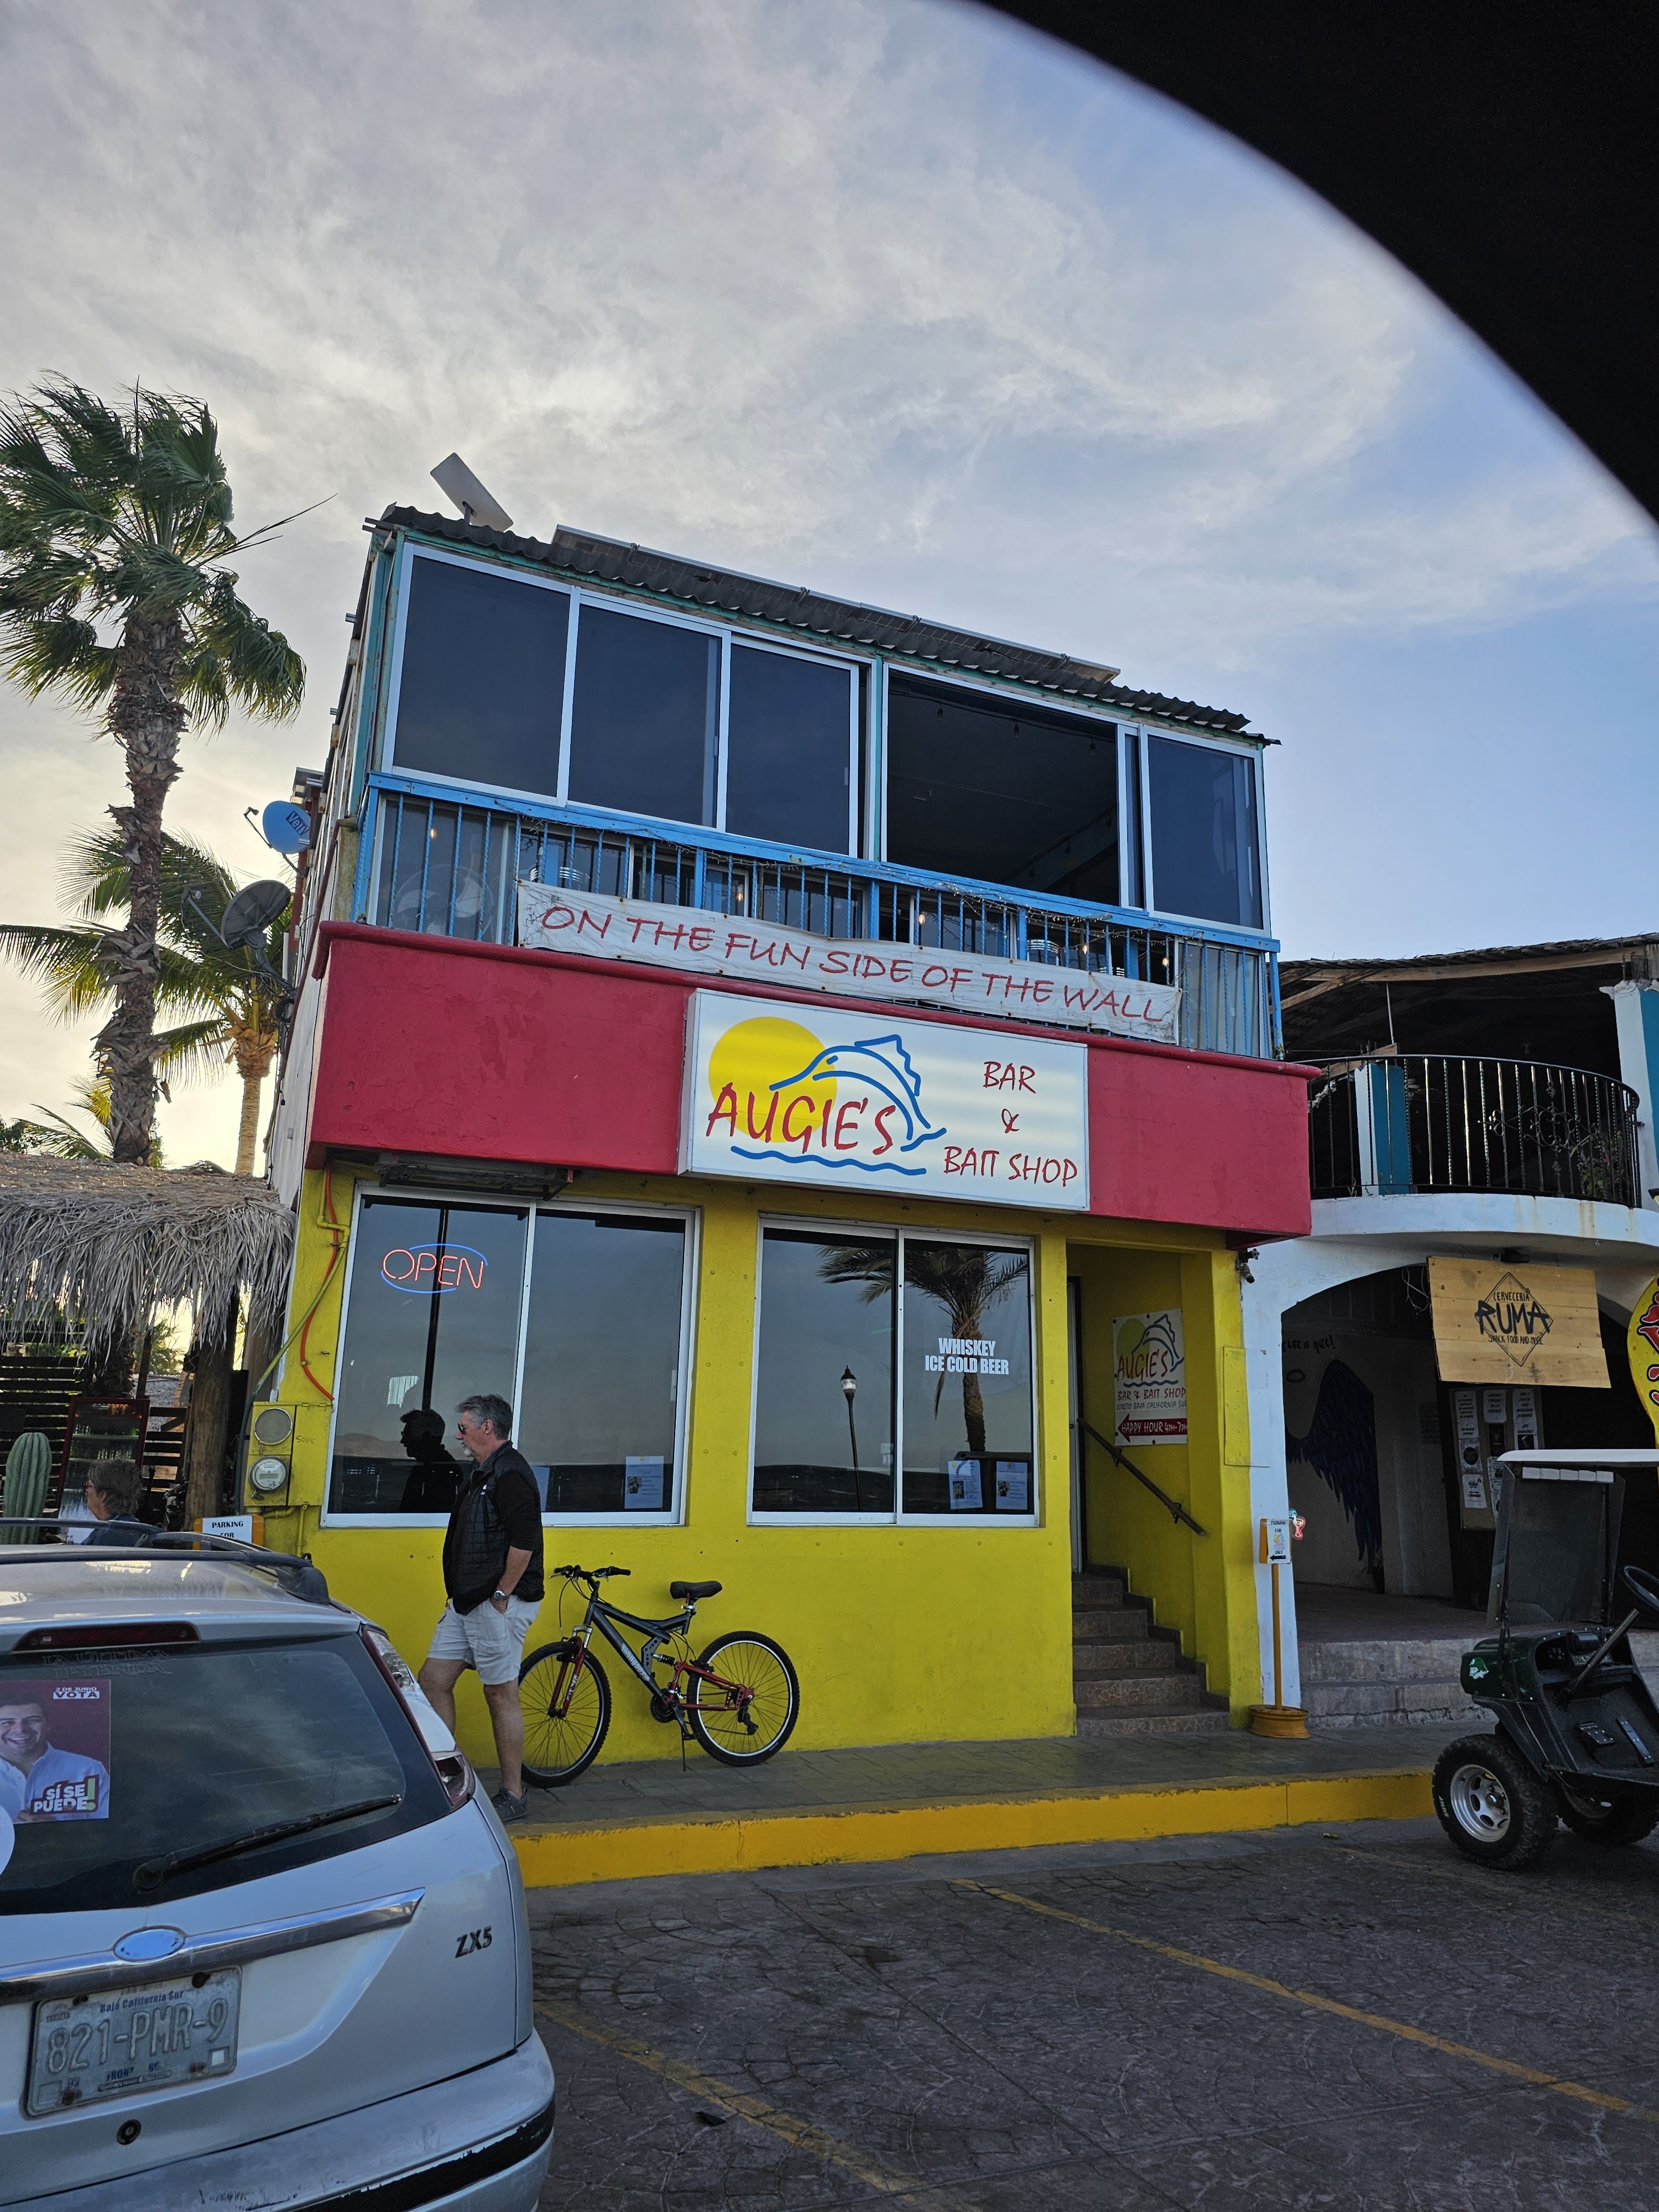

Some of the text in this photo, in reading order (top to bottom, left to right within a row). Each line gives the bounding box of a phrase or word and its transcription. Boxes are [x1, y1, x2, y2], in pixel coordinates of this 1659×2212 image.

[542, 906, 1163, 1022] ON THE FUN SIDE OF THE WALL
[983, 1061, 1036, 1094] BAR
[706, 1082, 896, 1156] AUGIE'S
[1001, 1108, 1020, 1134] &
[943, 1146, 1078, 1187] BAIT SHOP
[383, 1249, 484, 1290] OPEN
[1494, 1292, 1530, 1302] CERVECERIA
[1474, 1300, 1551, 1335] RUMA
[938, 1337, 996, 1357] WHISKEY
[1507, 1335, 1519, 1344] FOOD
[1520, 1335, 1530, 1344] AND
[925, 1355, 1009, 1375] ICE COLD BEER
[1117, 1348, 1168, 1381] AUGIE'S
[1117, 1402, 1133, 1411] LORETO
[1146, 1400, 1177, 1409] CALIFORNIA
[1118, 1387, 1187, 1401] BAR & BAIT SHOP
[1121, 1422, 1142, 1433] HAPPY
[1144, 1421, 1164, 1433] HOUR
[46, 1783, 86, 1800] SÍ SE
[455, 1925, 493, 1958] ZX5
[48, 1997, 229, 2075] 821-PMR-9
